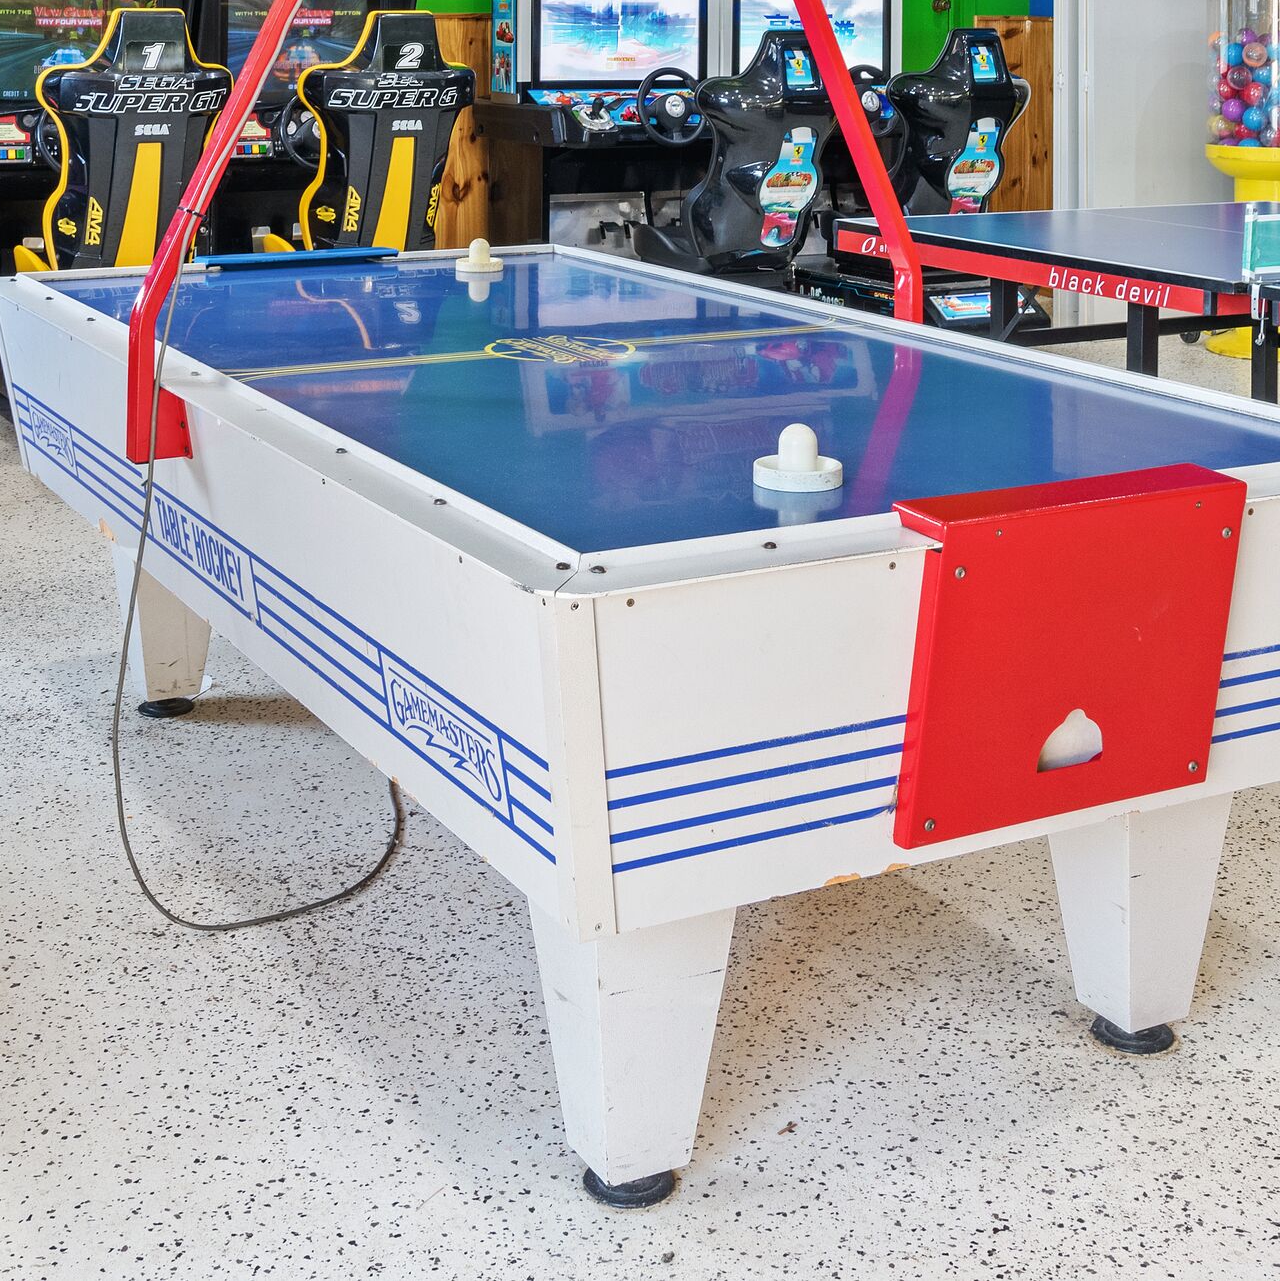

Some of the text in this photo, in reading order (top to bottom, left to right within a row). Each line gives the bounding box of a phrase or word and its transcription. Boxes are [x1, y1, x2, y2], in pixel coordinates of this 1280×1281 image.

[142, 42, 166, 70] 1
[395, 42, 424, 70] 2
[119, 75, 195, 91] SEGA
[73, 87, 227, 114] SUPER GT
[328, 88, 439, 109] SUPER
[134, 124, 171, 136] SEGA
[391, 119, 424, 131] SEGA
[1047, 266, 1171, 307] black devil
[153, 494, 245, 602] TABLE HOCKEY
[390, 678, 503, 803] GAMEMASTERS
